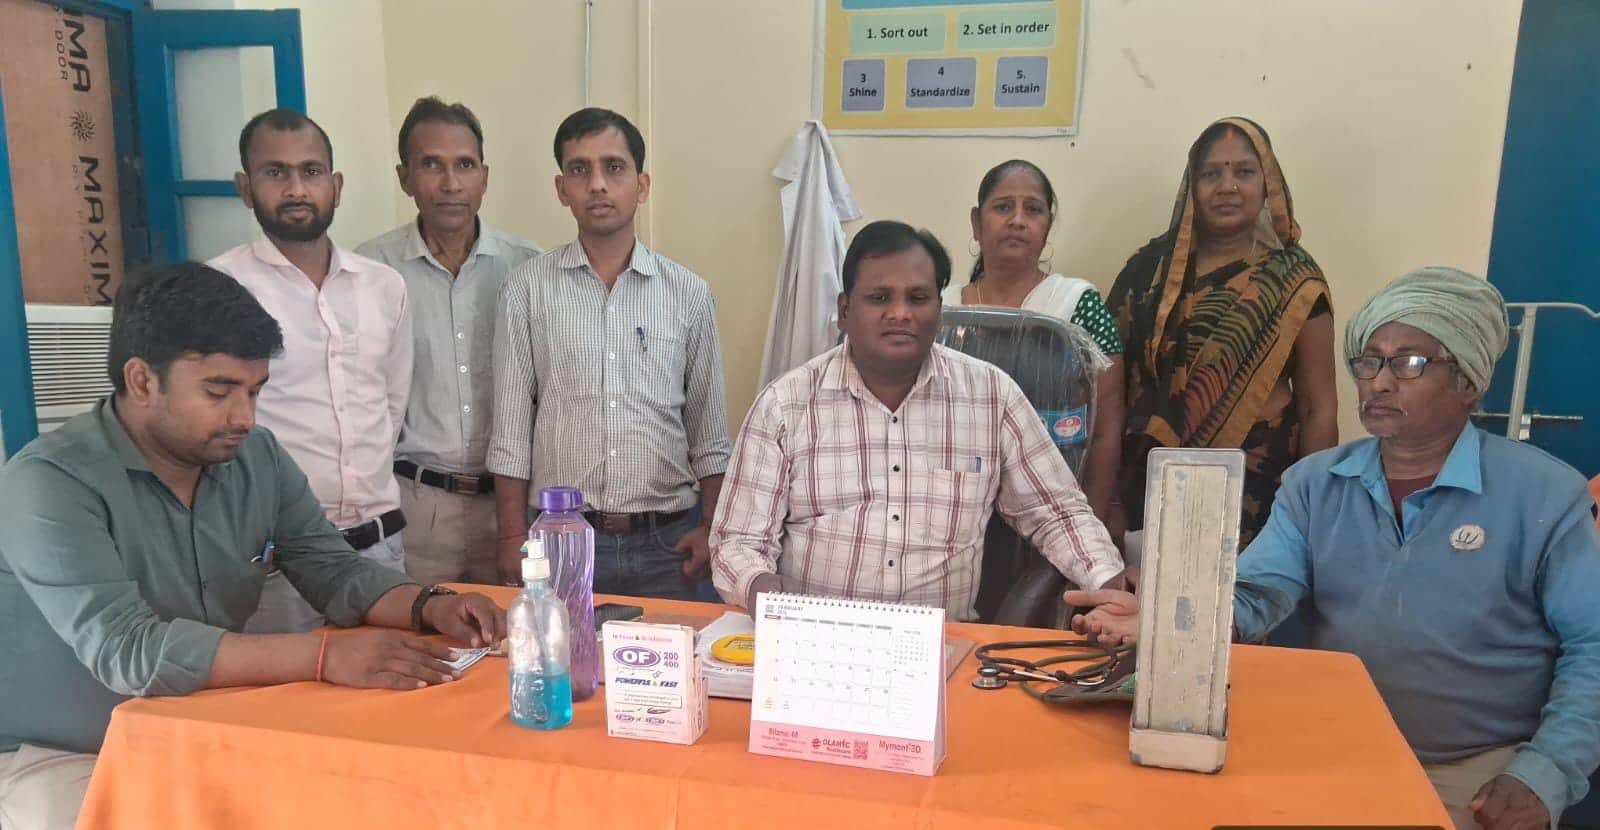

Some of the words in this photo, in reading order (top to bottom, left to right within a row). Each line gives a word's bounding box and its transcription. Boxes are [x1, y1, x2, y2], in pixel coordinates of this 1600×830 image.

[867, 28, 877, 39] 1.
[880, 27, 904, 39] Sort
[908, 27, 928, 38] out
[963, 24, 974, 35] 2.
[977, 23, 997, 35] Set
[1000, 22, 1011, 34] in
[1015, 21, 1050, 34] order
[937, 67, 945, 76] 4
[1016, 70, 1026, 80] 5.
[860, 73, 866, 83] 3
[849, 87, 877, 97] Shine
[910, 86, 971, 98] Standardize
[1001, 83, 1040, 94] Sustain
[79, 155, 112, 306] MAXIM
[622, 650, 650, 665] OF
[664, 652, 679, 660] 200
[664, 661, 679, 669] 400
